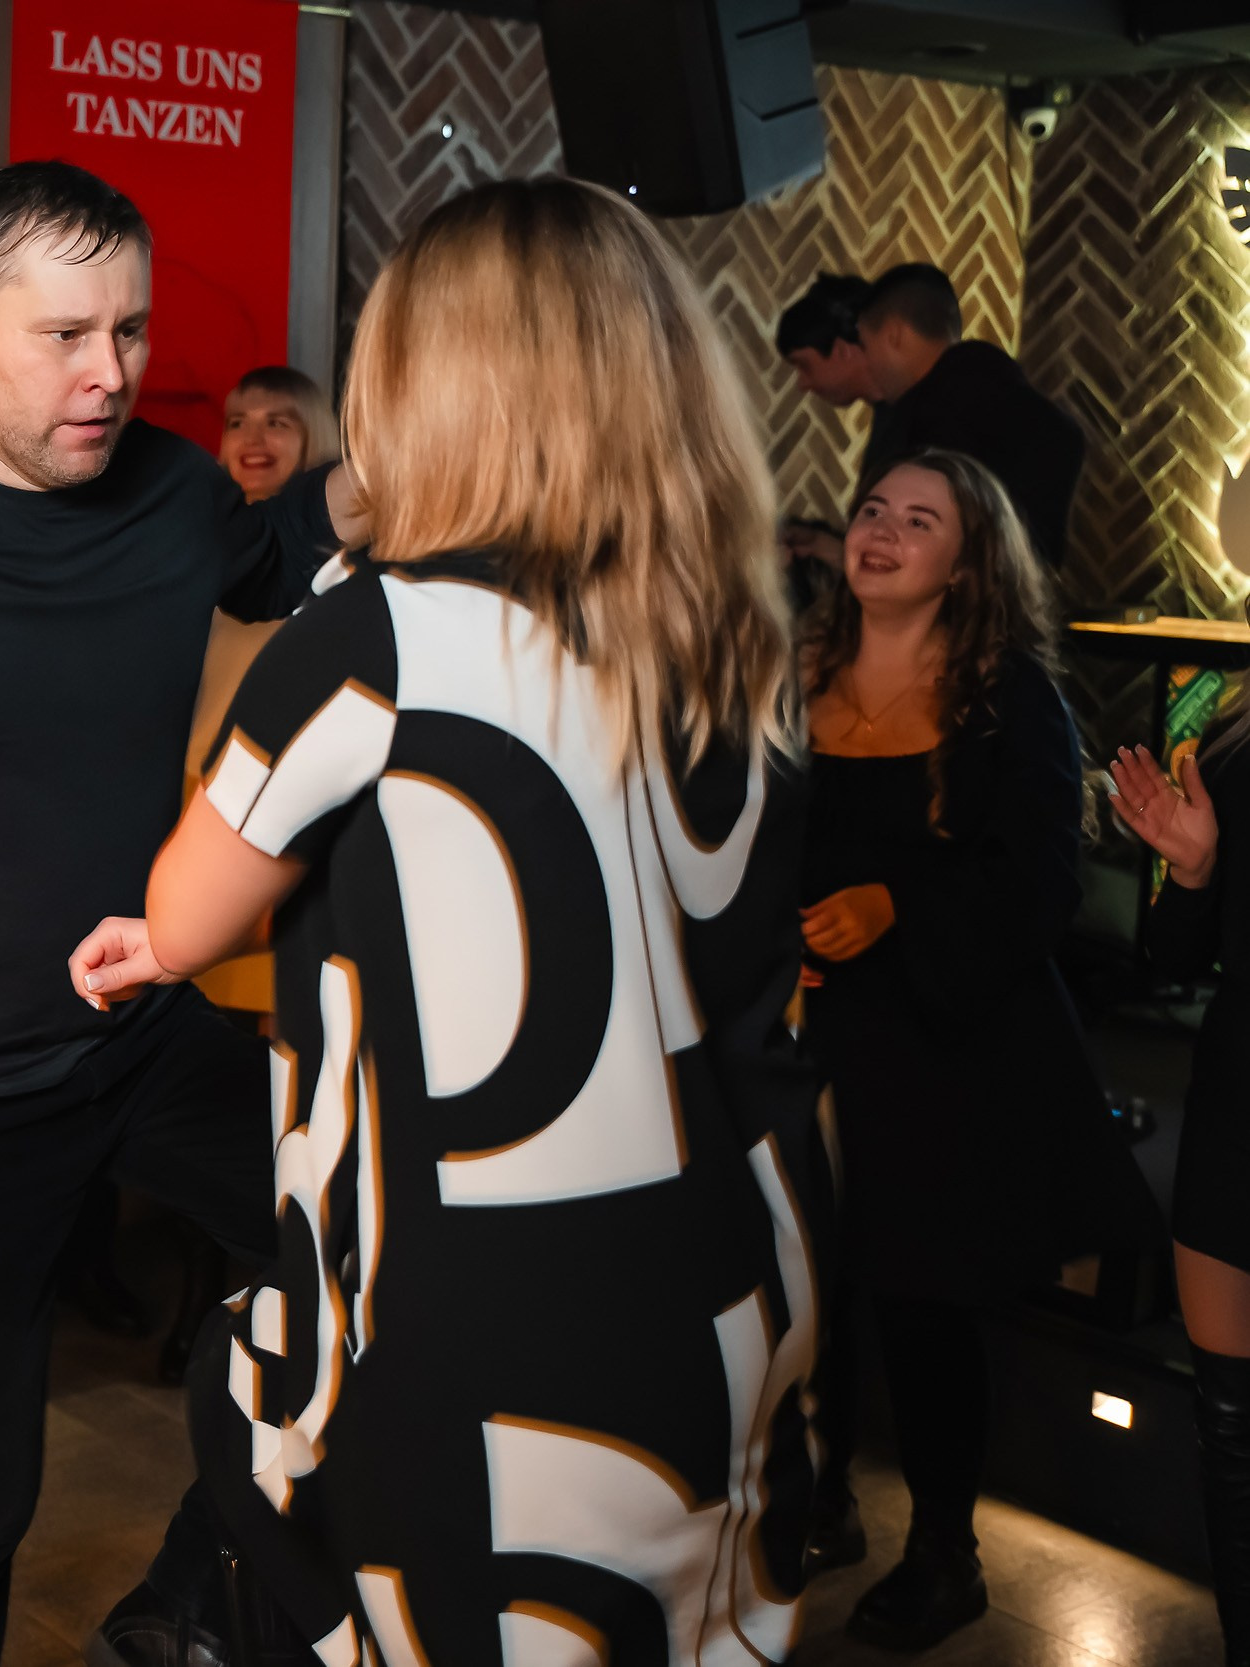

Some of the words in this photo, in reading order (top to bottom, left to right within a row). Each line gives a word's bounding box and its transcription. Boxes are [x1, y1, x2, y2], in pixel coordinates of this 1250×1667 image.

[51, 31, 162, 80] LASS
[176, 46, 262, 92] UNS
[67, 93, 243, 147] TANZEN
